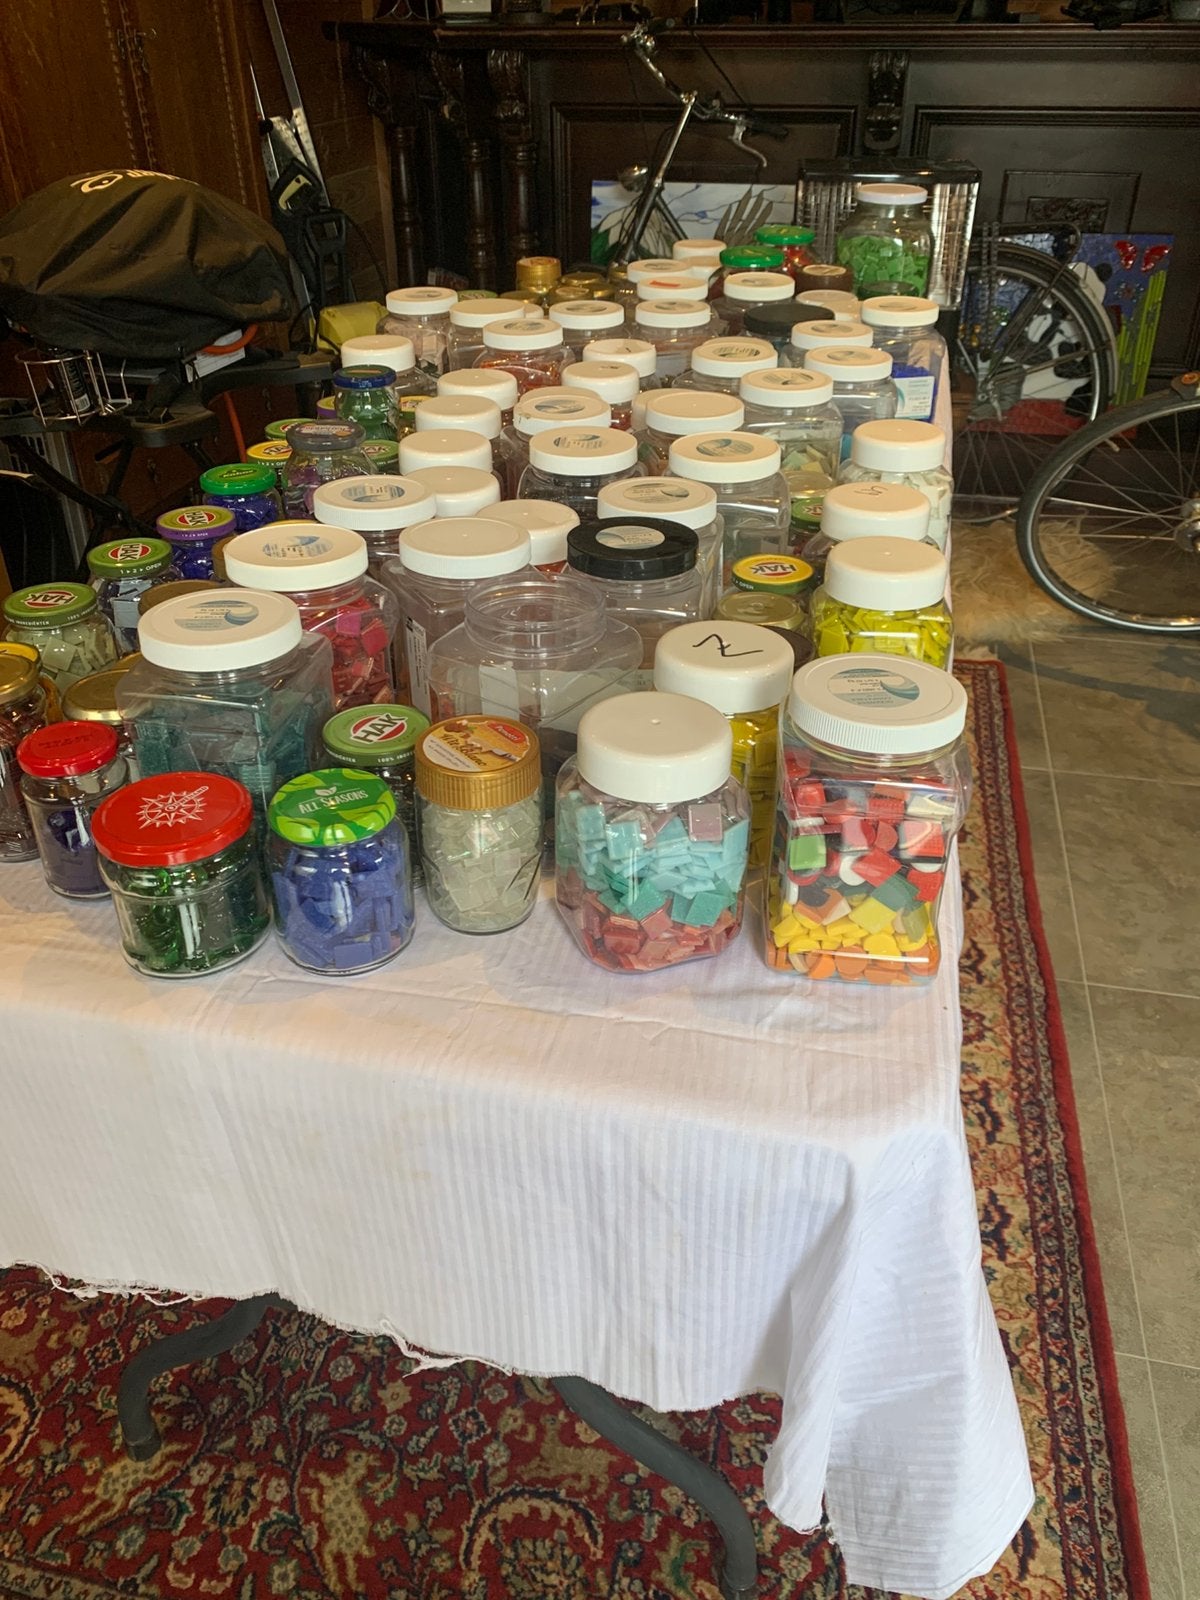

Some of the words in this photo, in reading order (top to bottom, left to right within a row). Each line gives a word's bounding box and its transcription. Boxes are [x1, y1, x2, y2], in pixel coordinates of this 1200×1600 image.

[186, 510, 208, 526] HAK
[119, 543, 141, 561] HAK
[750, 564, 797, 575] HAK
[24, 593, 76, 605] HAK
[352, 713, 405, 743] HAK
[298, 801, 322, 814] ALL
[321, 789, 369, 808] SEASONS
